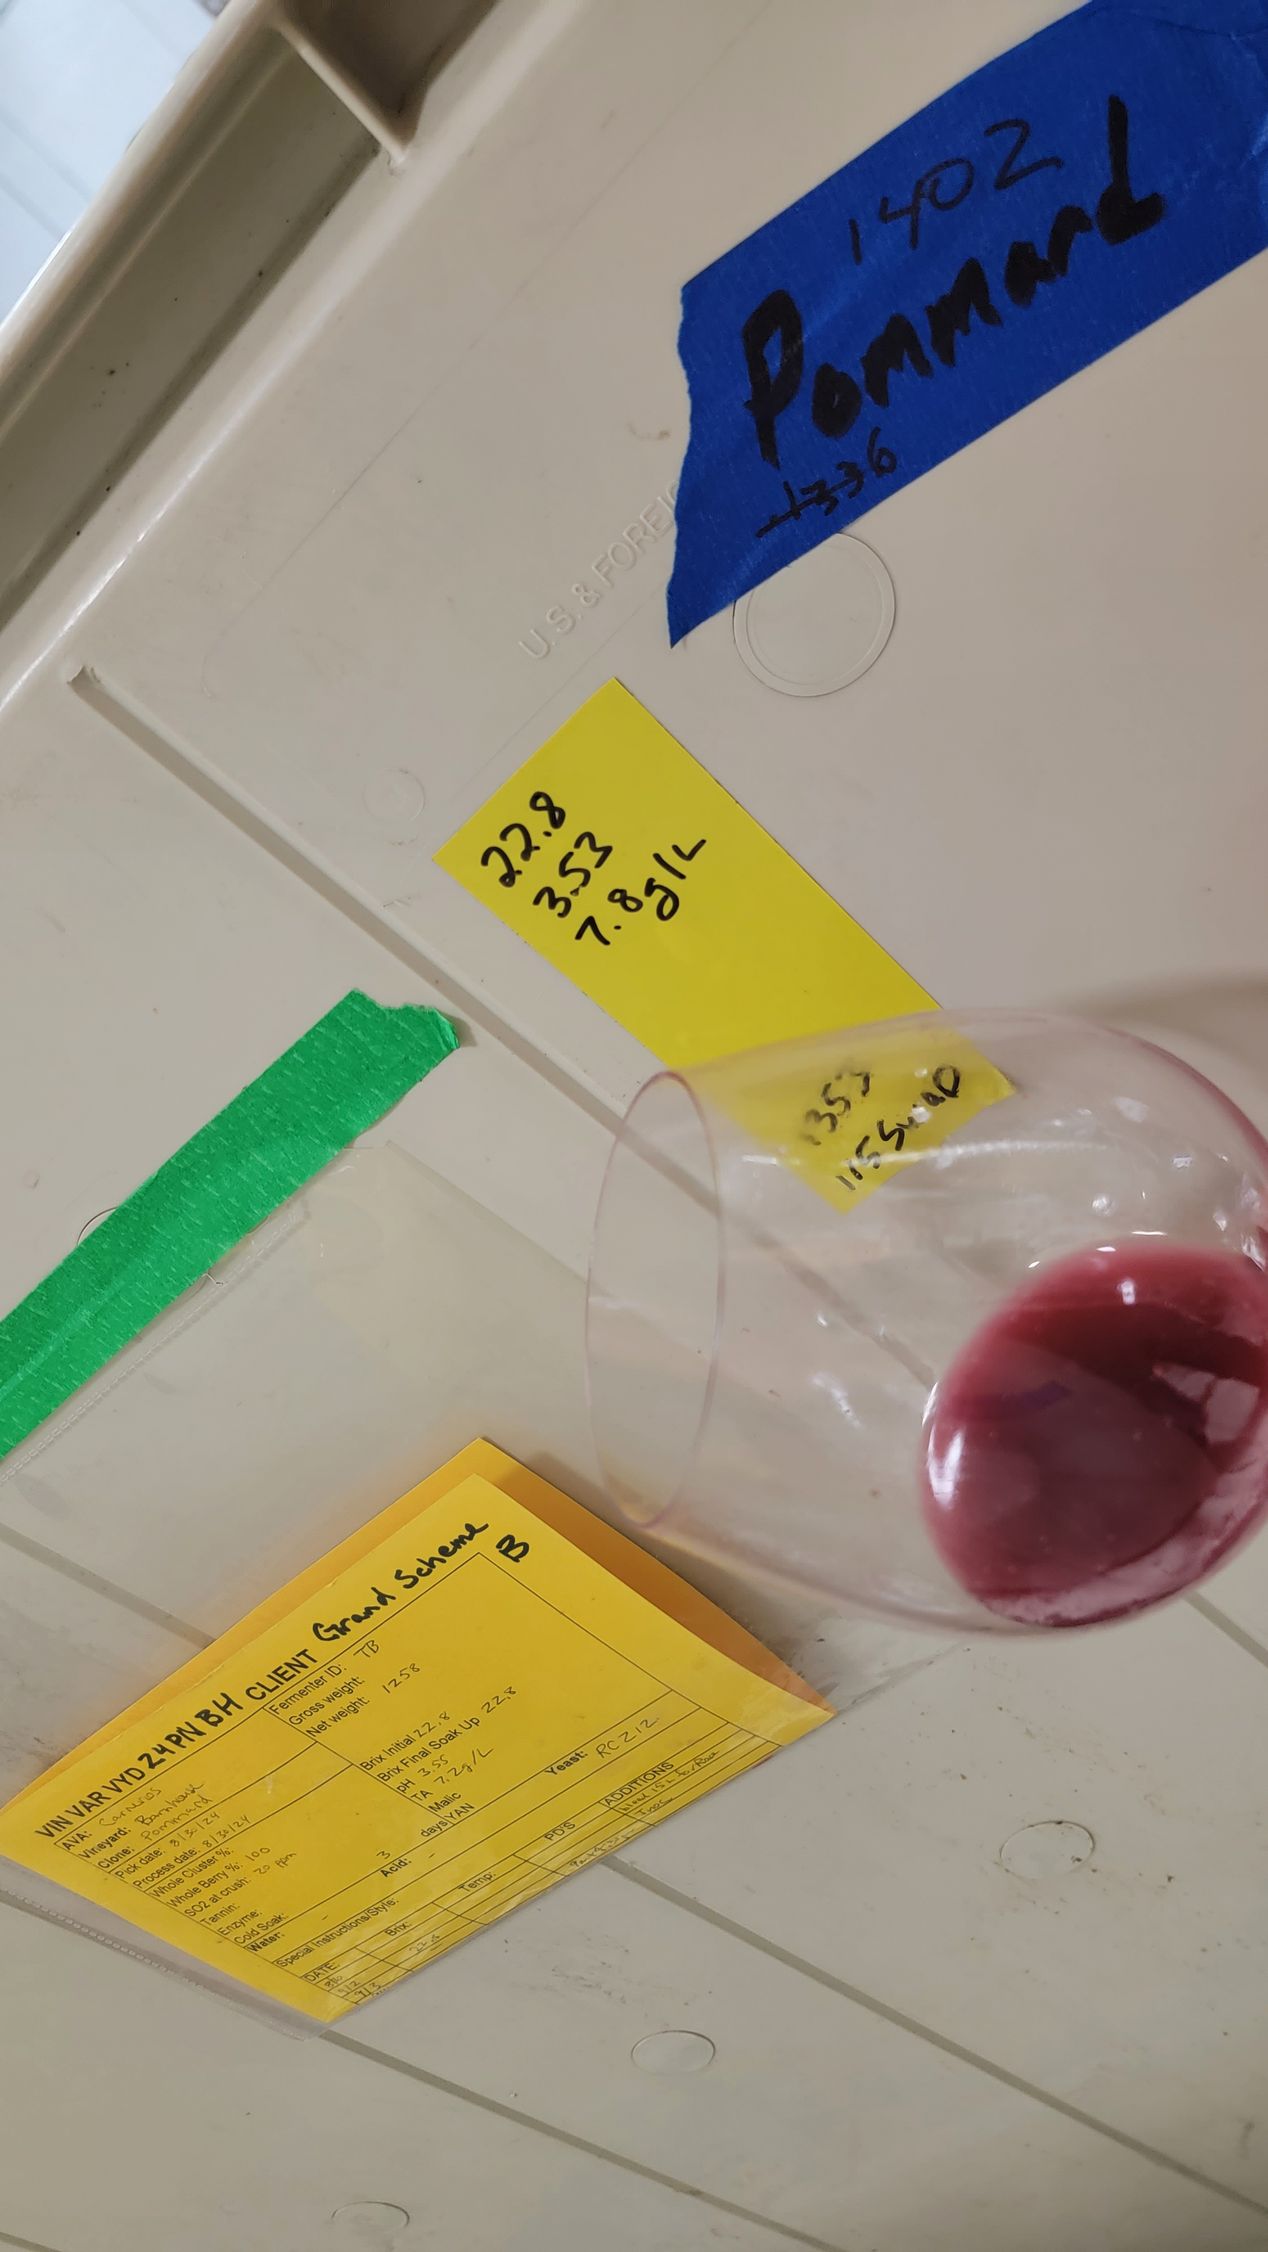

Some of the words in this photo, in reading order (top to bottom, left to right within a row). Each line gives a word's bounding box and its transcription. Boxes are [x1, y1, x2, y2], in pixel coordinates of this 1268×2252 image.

[848, 118, 1063, 265] 1402
[742, 93, 1165, 470] Pommard
[518, 604, 583, 660] U.S.
[572, 583, 601, 608] &
[591, 478, 678, 589] FOREI
[480, 791, 566, 888] 22.8
[532, 831, 613, 918] 3.53
[495, 1533, 529, 1562] B
[34, 1813, 73, 1838] VIN
[65, 1788, 111, 1820] VAR
[101, 1768, 145, 1794] VYD
[245, 1647, 318, 1701] CLIENT
[313, 1586, 396, 1641] Grand
[394, 1522, 489, 1588] Scheme
[268, 1674, 327, 1715] Fermenter
[324, 1662, 346, 1678] ID:
[288, 1702, 325, 1725] Gross
[321, 1675, 365, 1703] weight:
[305, 1719, 331, 1737] Net
[328, 1695, 370, 1722] weight:
[381, 1662, 421, 1693] 1258
[359, 1752, 386, 1772] Brix
[382, 1732, 416, 1756] Initial
[376, 1763, 403, 1783] Brix
[399, 1744, 432, 1768] Final
[429, 1726, 462, 1751] Soak
[457, 1715, 481, 1730] Up
[395, 1777, 415, 1794] pH
[410, 1788, 433, 1802] TA
[427, 1789, 462, 1813] Malic
[446, 1801, 475, 1821] YAN
[61, 1831, 92, 1850] AVA:
[77, 1827, 131, 1860] Vineyard:
[97, 1843, 135, 1868] Clone:
[114, 1863, 140, 1879] Pick
[137, 1846, 165, 1865] date:
[246, 1929, 285, 1953] Water:
[380, 1854, 412, 1878] Acid:
[544, 1748, 588, 1776] Yeast:
[383, 1919, 412, 1938] Brix:
[456, 1870, 496, 1894] Temp:
[602, 1760, 674, 1807] ADDITIONS
[132, 1860, 176, 1889] Process
[173, 1846, 200, 1864] date:
[147, 1875, 185, 1899] Whole
[183, 1853, 219, 1877] Cluster
[166, 1885, 202, 1908] Whole
[197, 1868, 228, 1888] Berry
[219, 1874, 252, 1897] crush:
[233, 1926, 260, 1945] Cold
[256, 1909, 288, 1932] Soak:
[419, 1818, 448, 1838] days
[199, 1901, 240, 1927] Tannin:
[217, 1907, 263, 1936] Enzyme:
[275, 1943, 314, 1967] Special
[311, 1896, 399, 1947] Instructions/Style:
